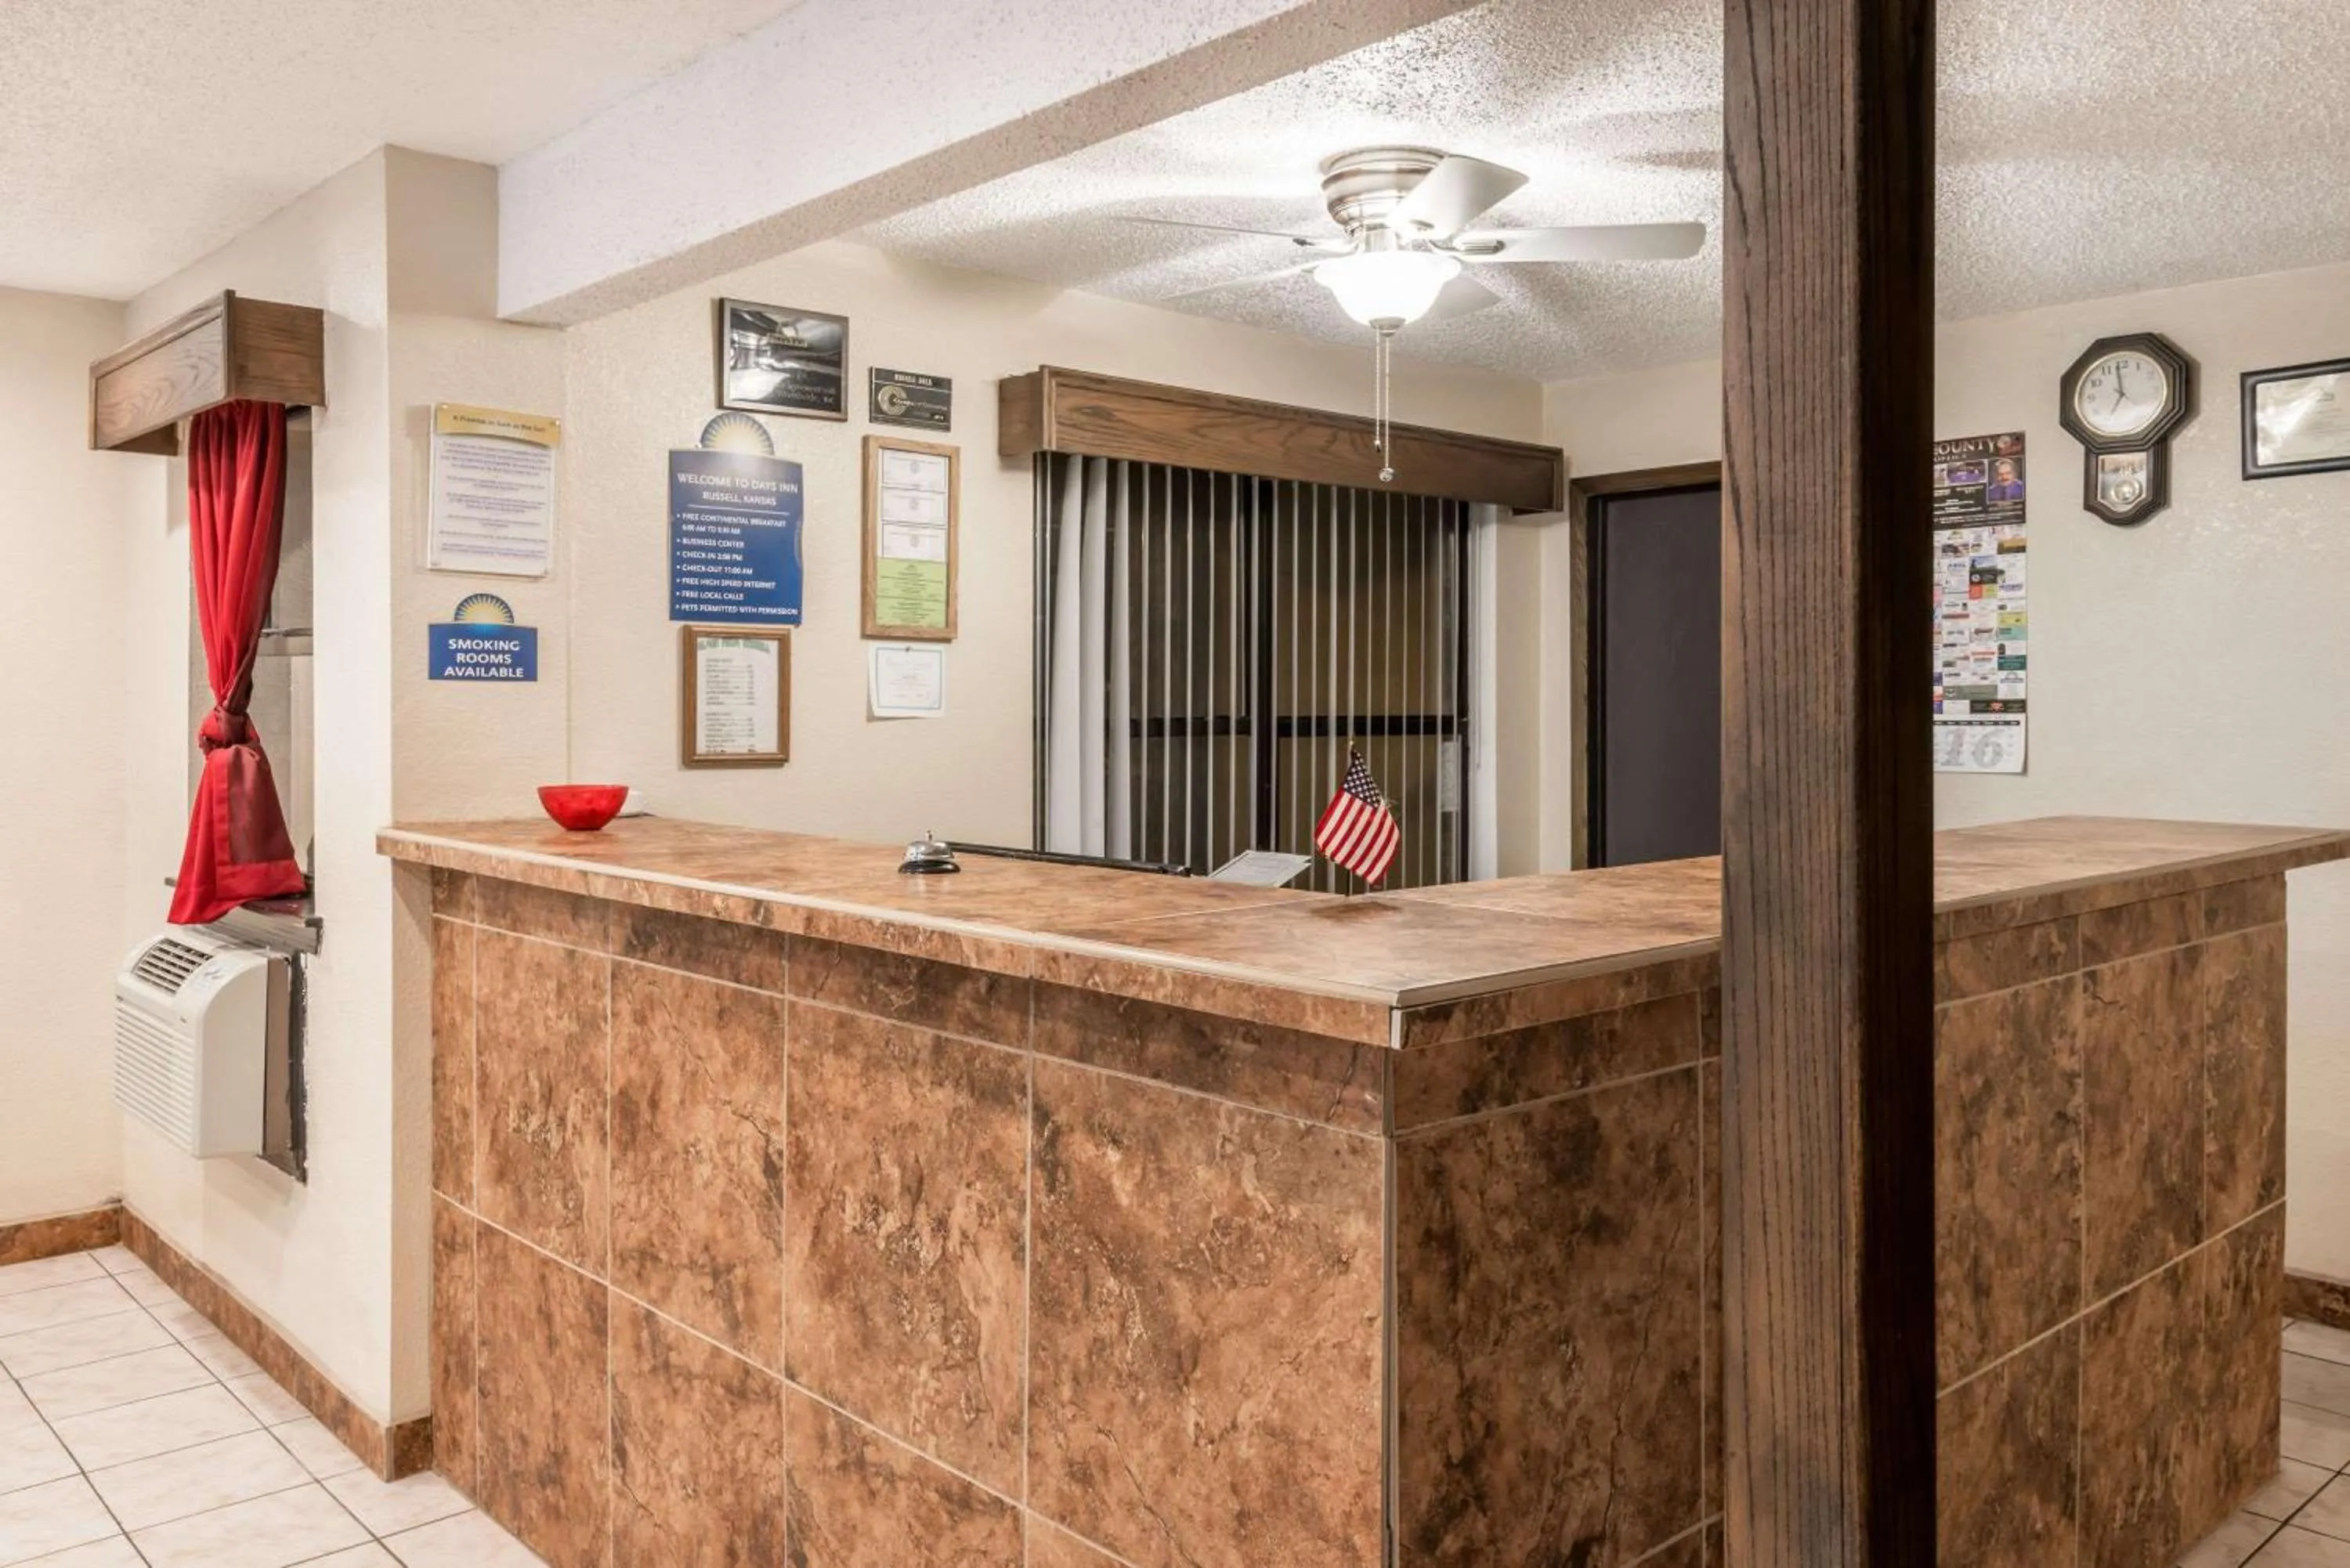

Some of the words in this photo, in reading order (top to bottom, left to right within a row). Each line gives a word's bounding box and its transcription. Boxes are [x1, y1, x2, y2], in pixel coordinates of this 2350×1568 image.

[2102, 366, 2111, 375] 11
[677, 473, 731, 486] WELCOME
[735, 477, 749, 488] TO
[751, 480, 777, 491] DAYS
[779, 482, 798, 494] INN
[743, 495, 776, 506] KANSAS
[700, 515, 749, 524] CONTINENTAL
[682, 538, 716, 547] BUSINESS
[718, 540, 745, 548] CENTER
[743, 581, 776, 590] INTERNET
[700, 605, 738, 613] PERMITTED
[448, 638, 520, 651] SMOKING
[457, 652, 512, 664] ROOMS
[444, 667, 524, 677] AVAILABLE
